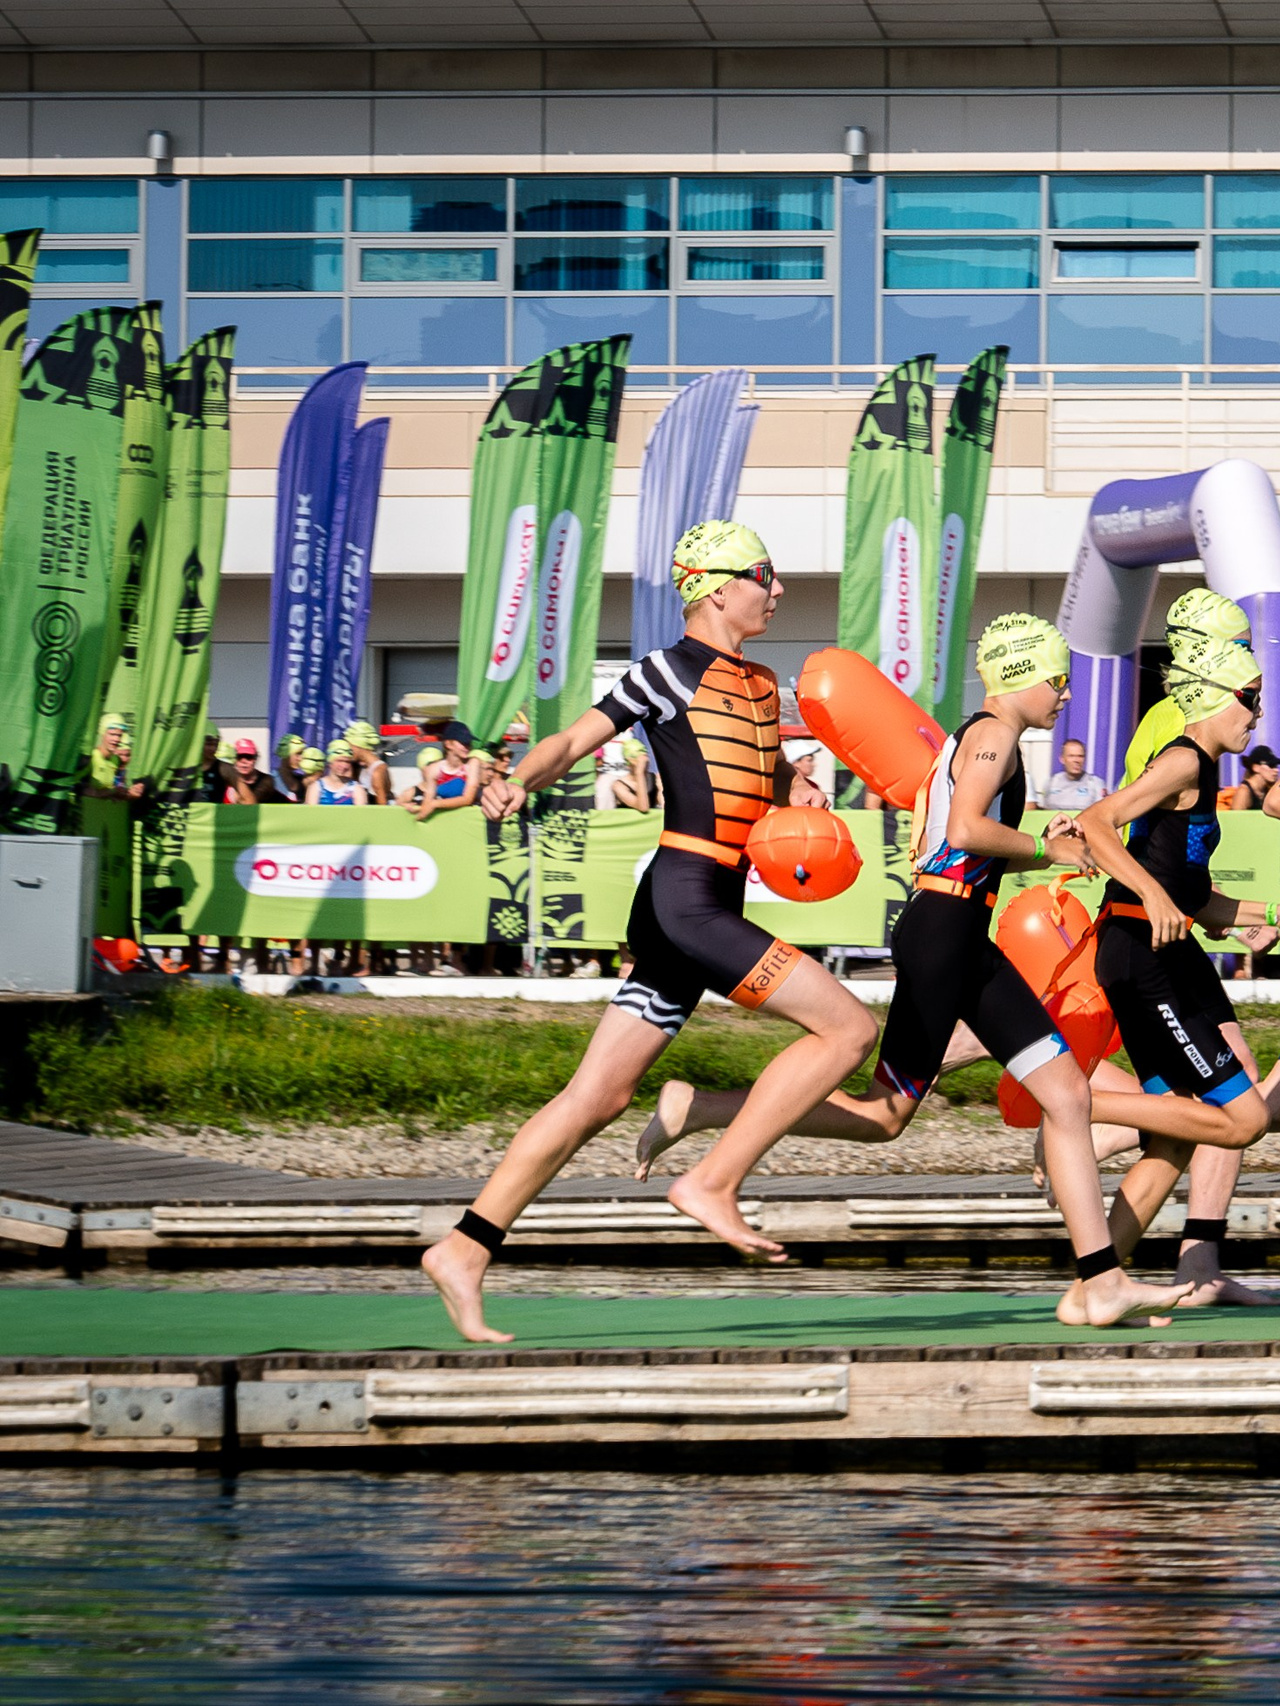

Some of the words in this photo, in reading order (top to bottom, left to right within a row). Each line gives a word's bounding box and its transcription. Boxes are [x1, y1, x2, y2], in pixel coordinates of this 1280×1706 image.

[39, 450, 61, 575] ФЕДЕРАЦИЯ
[57, 455, 77, 576] ТРИАТЛОНА
[75, 500, 91, 579] РОССИИ
[287, 493, 313, 594] банк
[1000, 664, 1036, 681] WAVE
[1002, 659, 1031, 673] MAD
[975, 751, 997, 761] 168
[288, 864, 420, 882] самокат
[743, 944, 793, 995] kafitt
[1157, 1003, 1190, 1044] RTS
[1187, 1046, 1210, 1076] POWER
